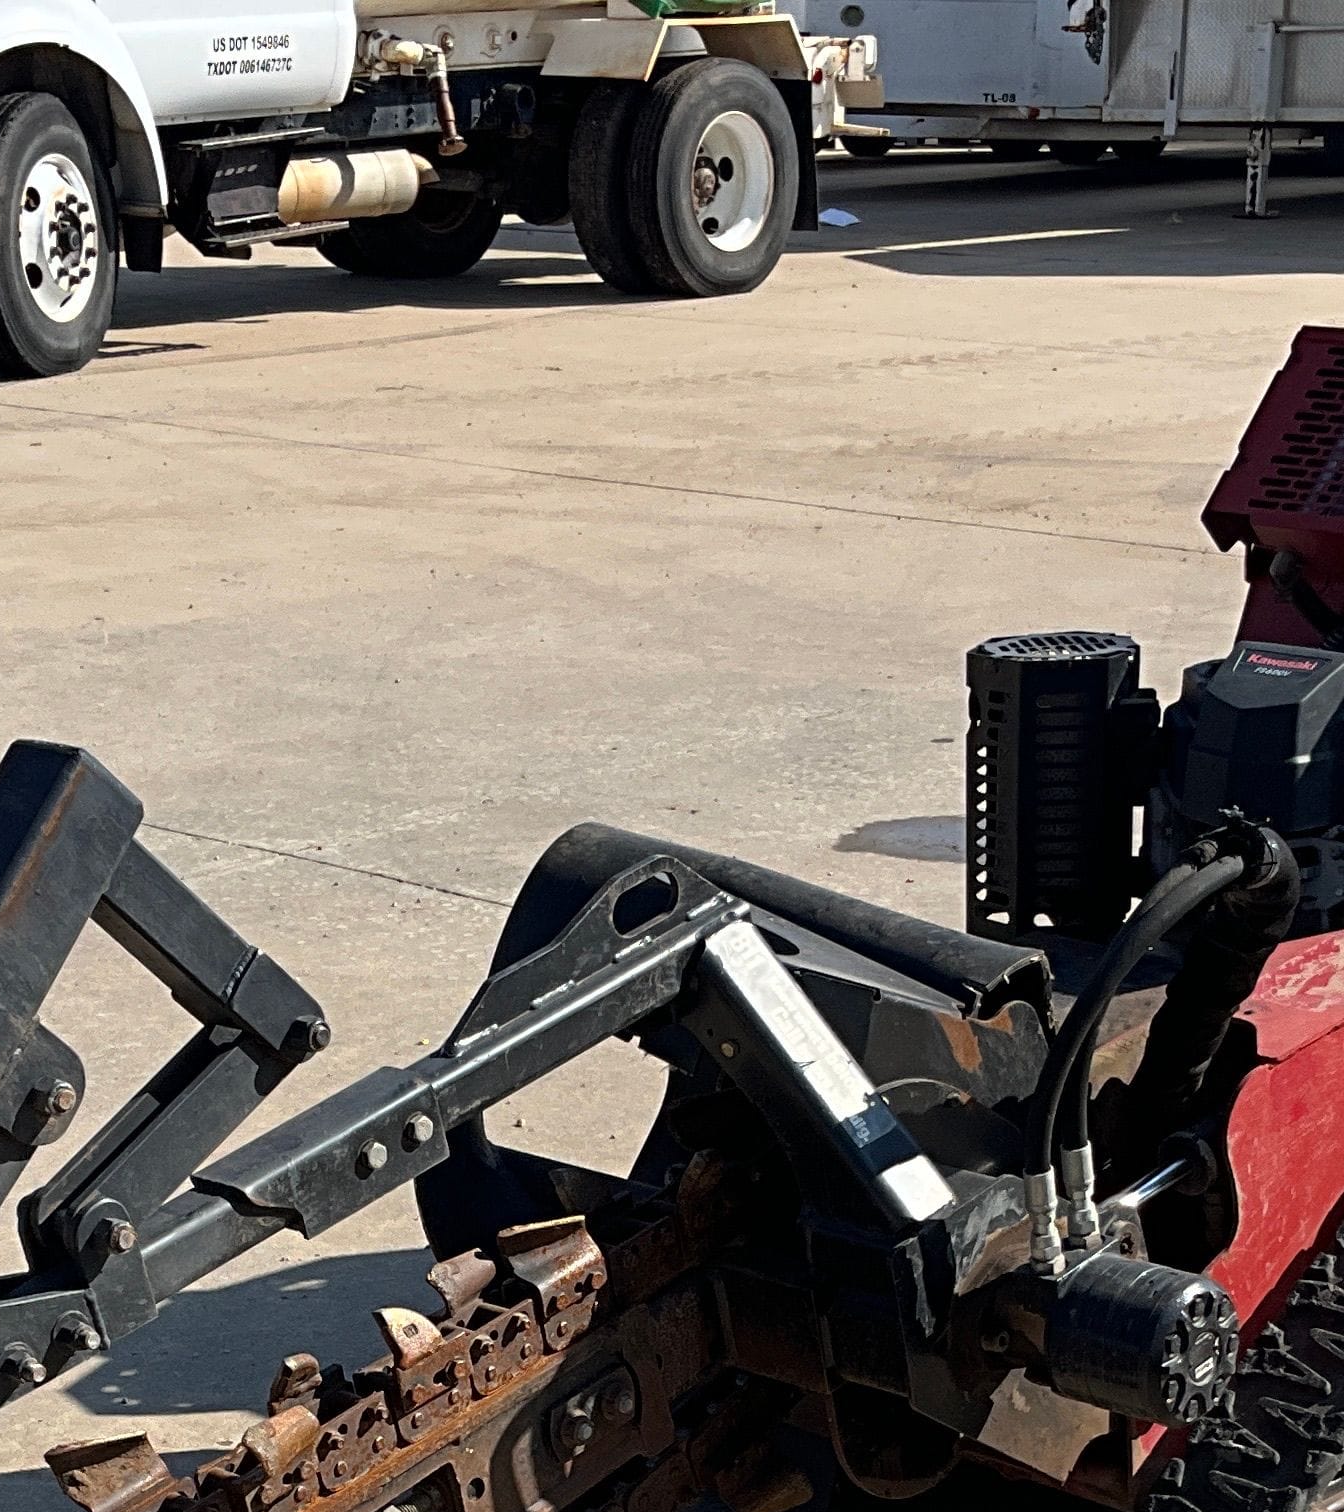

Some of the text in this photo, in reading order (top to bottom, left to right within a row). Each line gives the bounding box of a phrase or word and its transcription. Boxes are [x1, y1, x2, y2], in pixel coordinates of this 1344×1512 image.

[213, 34, 289, 52] US DOT 1549846
[207, 61, 237, 76] TXDOT
[1247, 653, 1318, 671] Kawasaki
